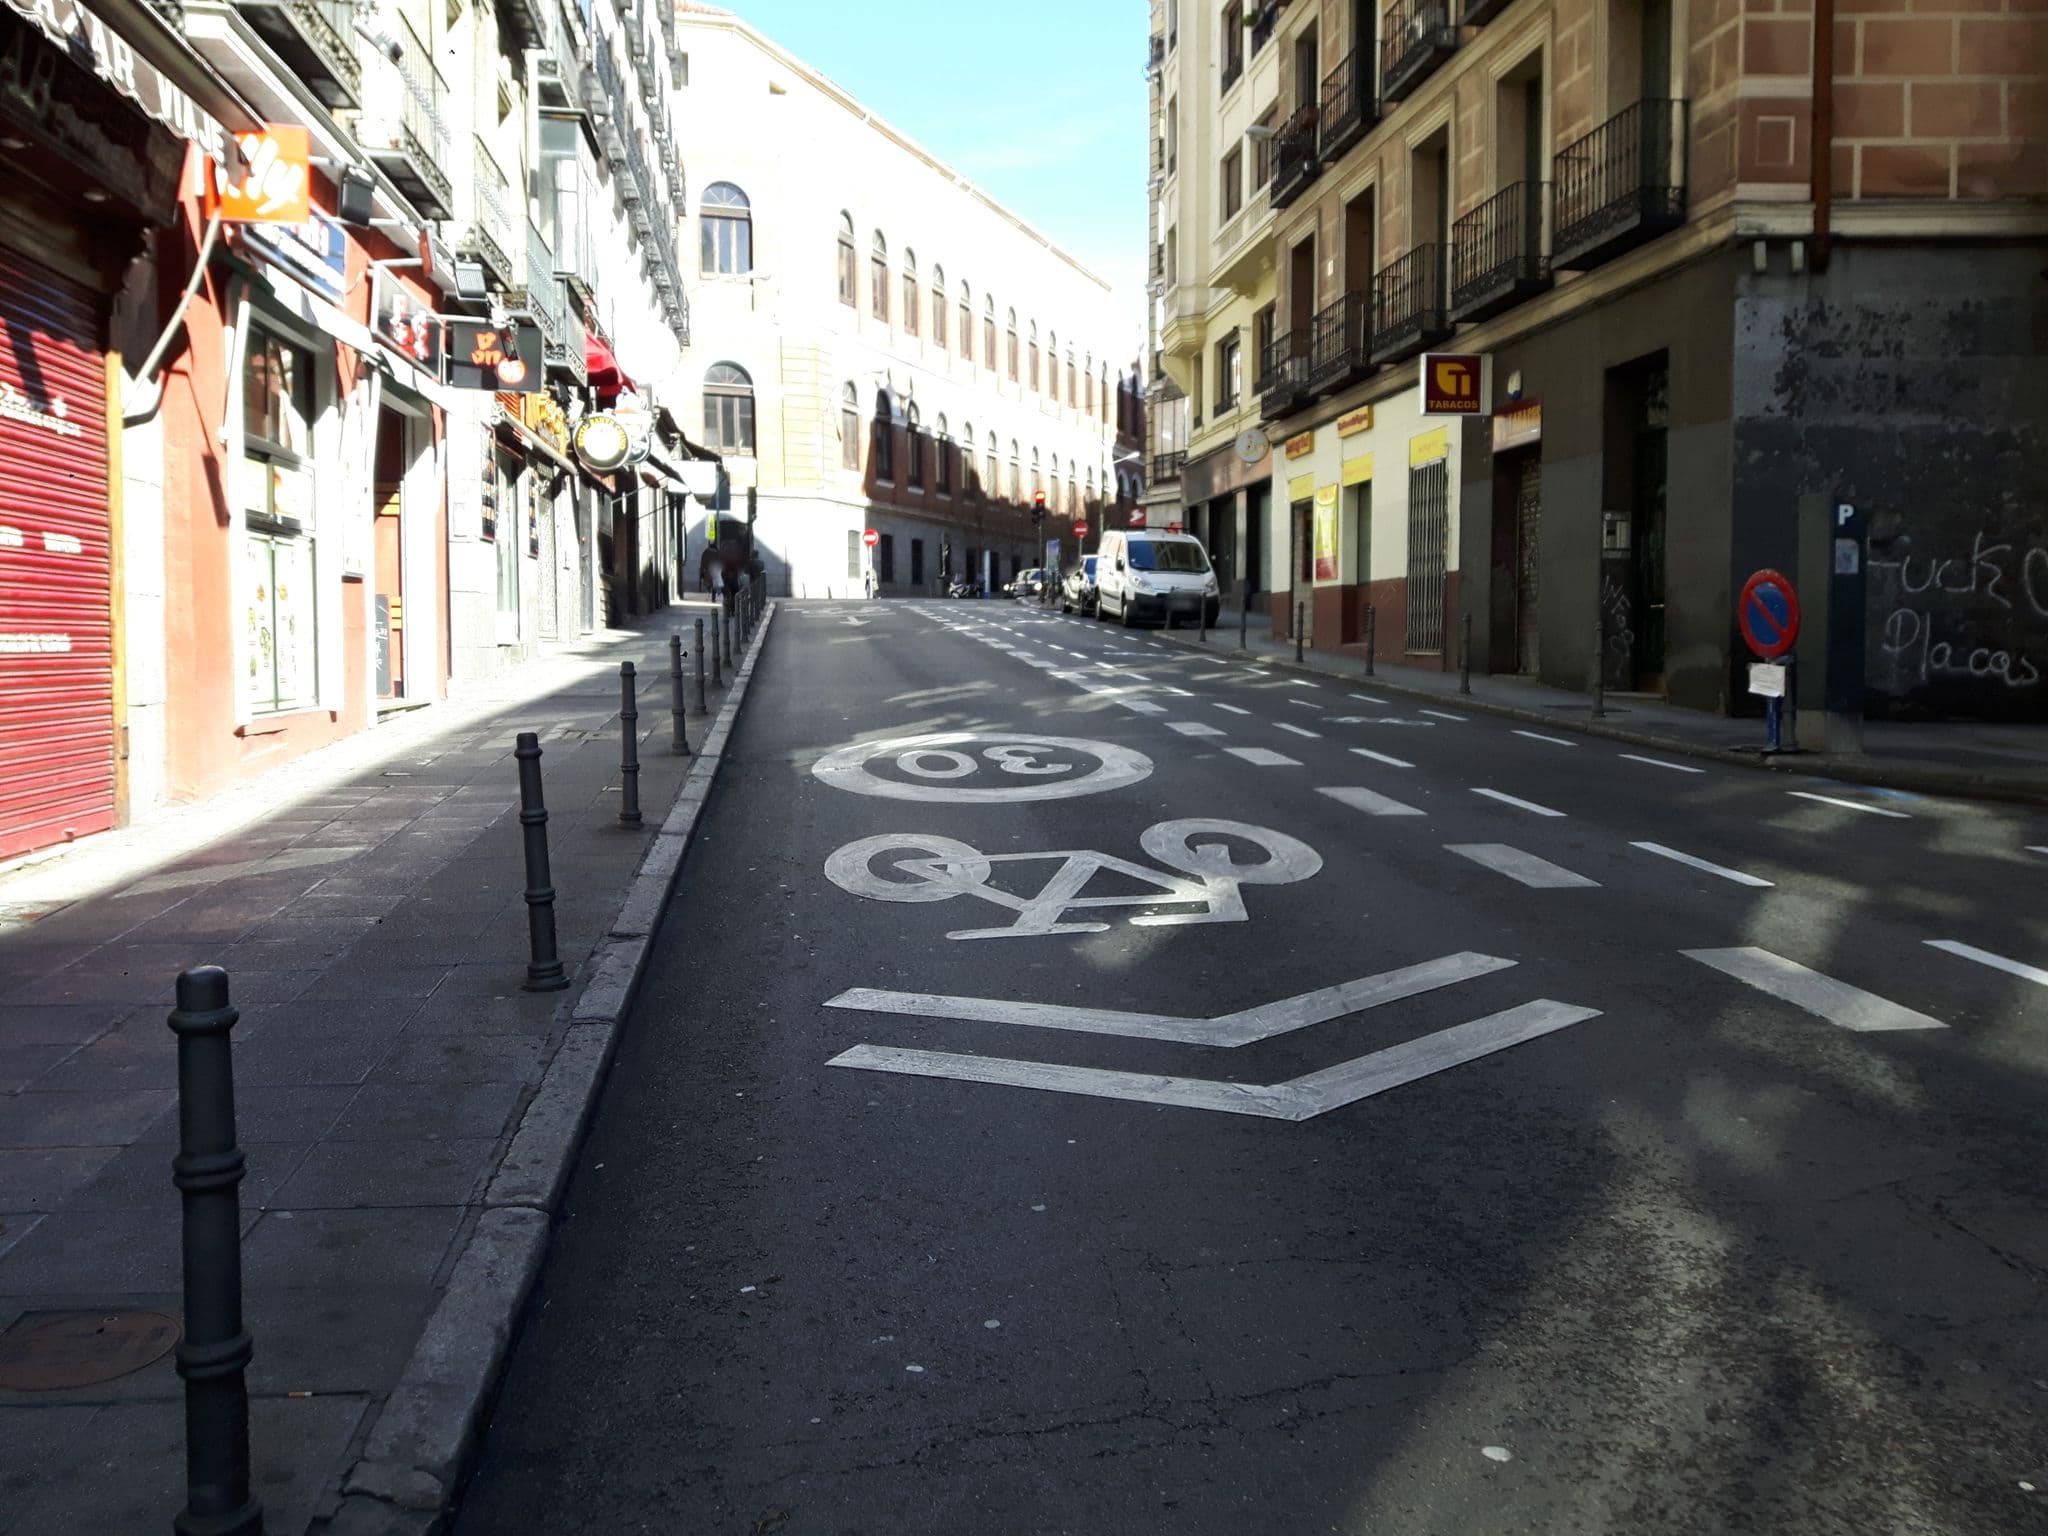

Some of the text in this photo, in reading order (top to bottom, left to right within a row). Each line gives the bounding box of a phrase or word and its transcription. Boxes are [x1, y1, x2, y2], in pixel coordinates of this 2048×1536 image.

[1430, 400, 1479, 409] TABACOS
[1838, 504, 1854, 525] P
[897, 744, 1073, 779] 30
